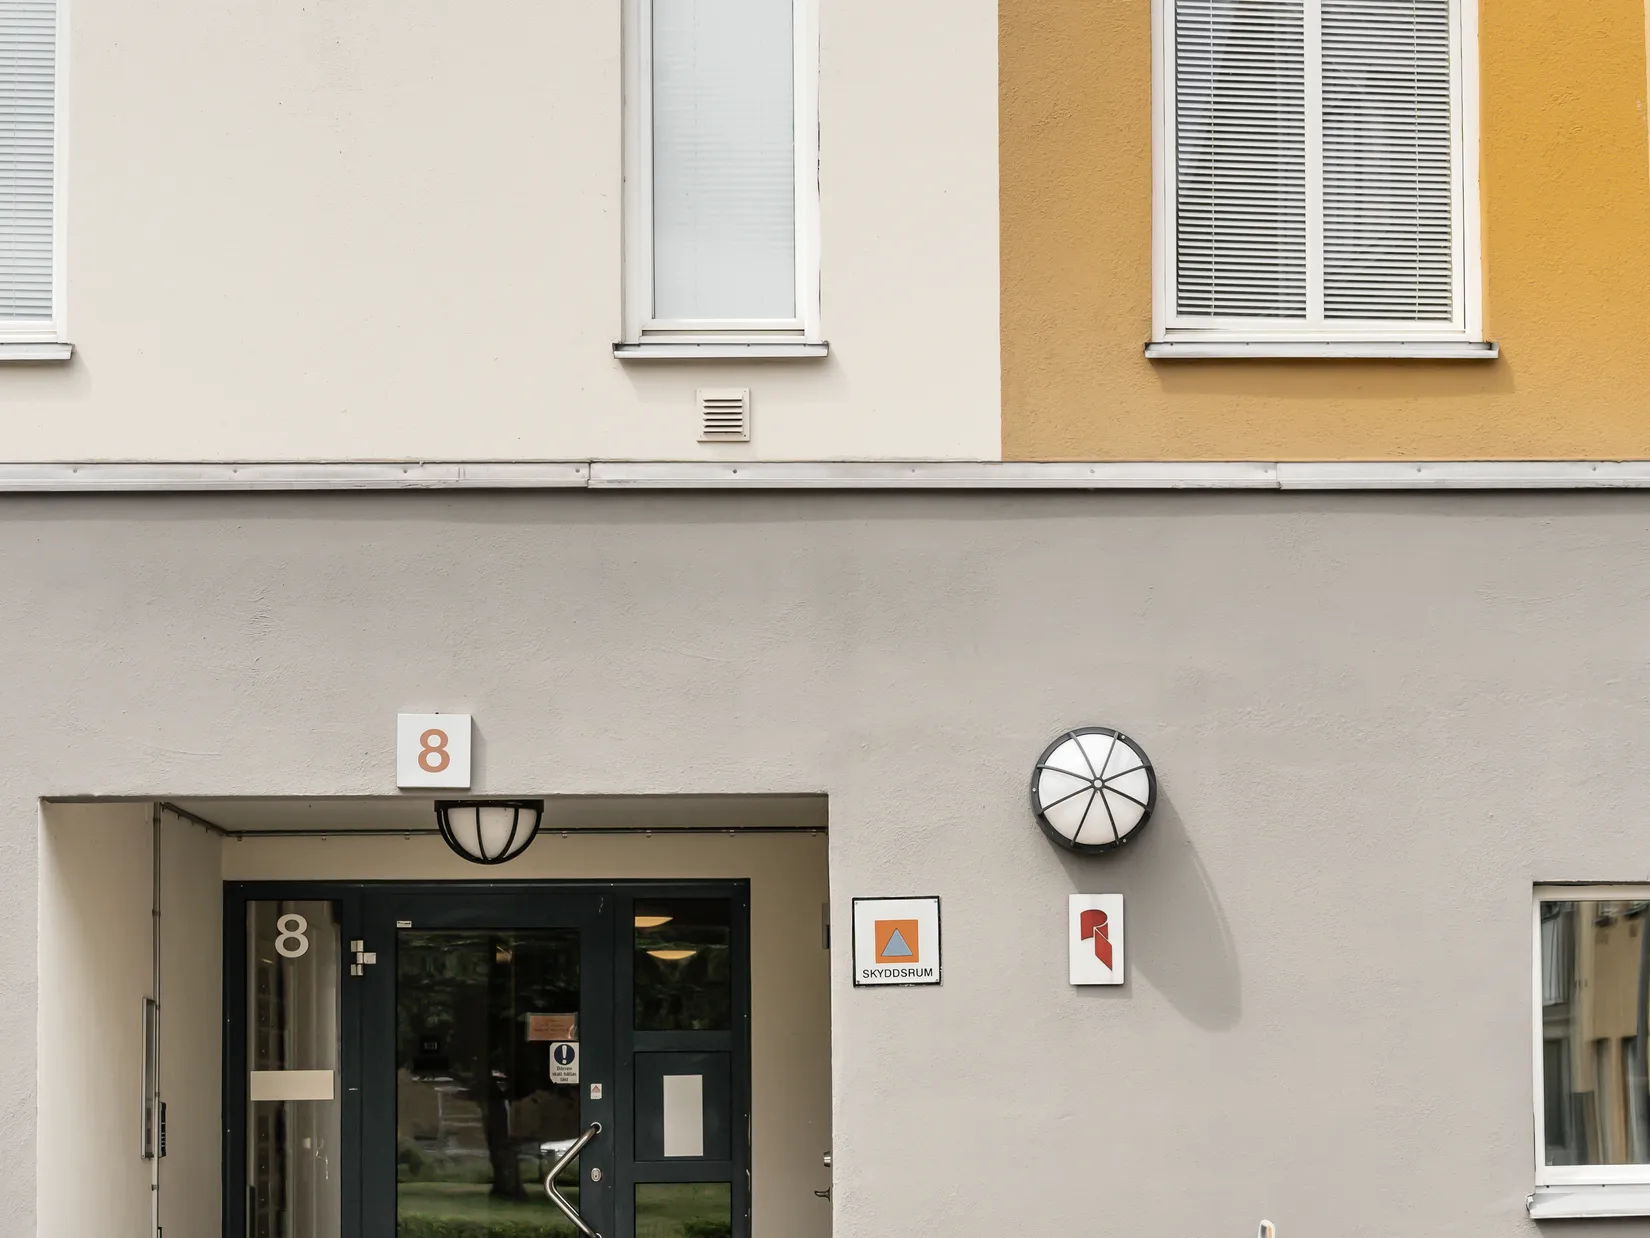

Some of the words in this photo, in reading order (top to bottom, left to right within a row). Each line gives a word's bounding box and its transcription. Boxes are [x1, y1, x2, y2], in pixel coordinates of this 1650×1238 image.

[418, 728, 450, 773] 8
[275, 914, 309, 958] 8
[862, 968, 933, 978] SKYDDSRUM
